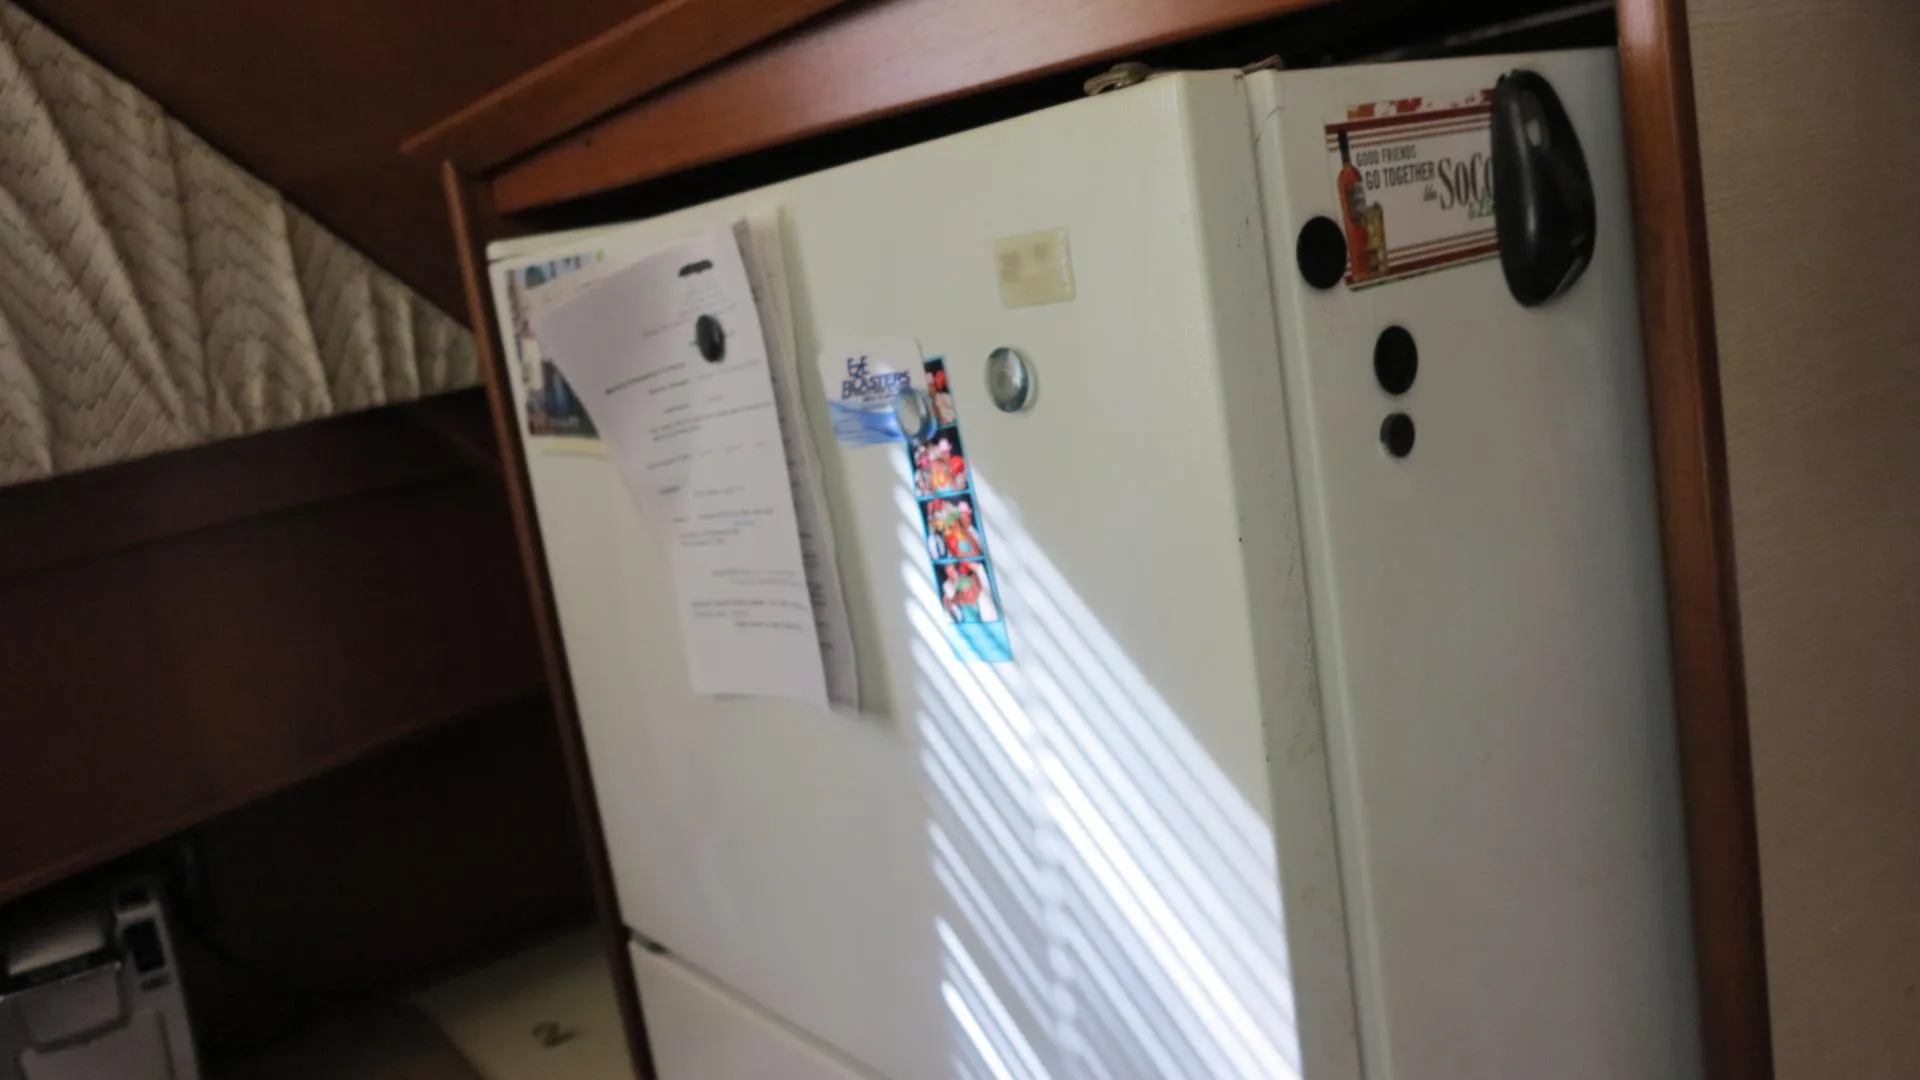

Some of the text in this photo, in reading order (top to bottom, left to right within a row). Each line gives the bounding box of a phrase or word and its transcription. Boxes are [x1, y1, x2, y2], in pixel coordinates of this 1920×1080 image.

[1356, 144, 1417, 167] GOOD FRIENDS
[1365, 161, 1435, 190] GO TOGETHER
